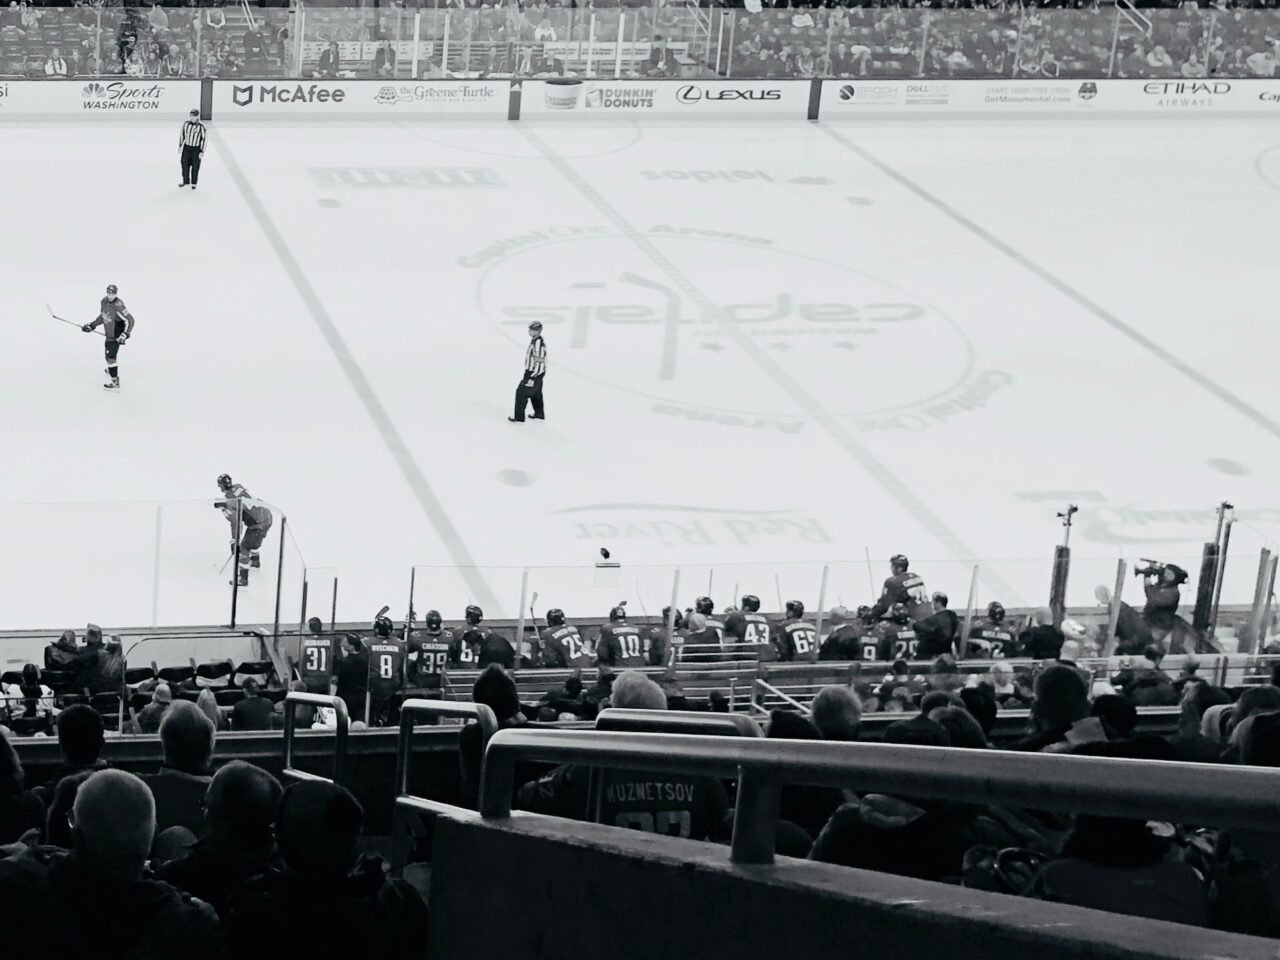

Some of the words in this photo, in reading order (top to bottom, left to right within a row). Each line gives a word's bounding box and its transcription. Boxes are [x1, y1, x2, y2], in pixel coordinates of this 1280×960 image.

[105, 82, 165, 100] Sports
[260, 85, 345, 103] McAfee
[400, 86, 413, 94] the
[414, 85, 455, 100] Greene
[458, 85, 494, 97] Turtle
[604, 88, 657, 97] DUNKIN'
[705, 90, 781, 100] LEXUS
[1143, 82, 1232, 94] ETIHAD
[83, 101, 159, 109] WASHINGTON
[604, 98, 653, 107] DONUTS
[457, 230, 549, 270] Capital
[549, 223, 608, 237] One
[647, 224, 774, 245] Arena
[572, 520, 720, 544] River
[727, 515, 835, 543] Red
[744, 623, 769, 644] 43
[620, 635, 640, 658] 10
[307, 647, 326, 672] 31
[380, 654, 393, 679] 8
[422, 652, 448, 674] 39
[606, 782, 694, 803] KUZNETSOV
